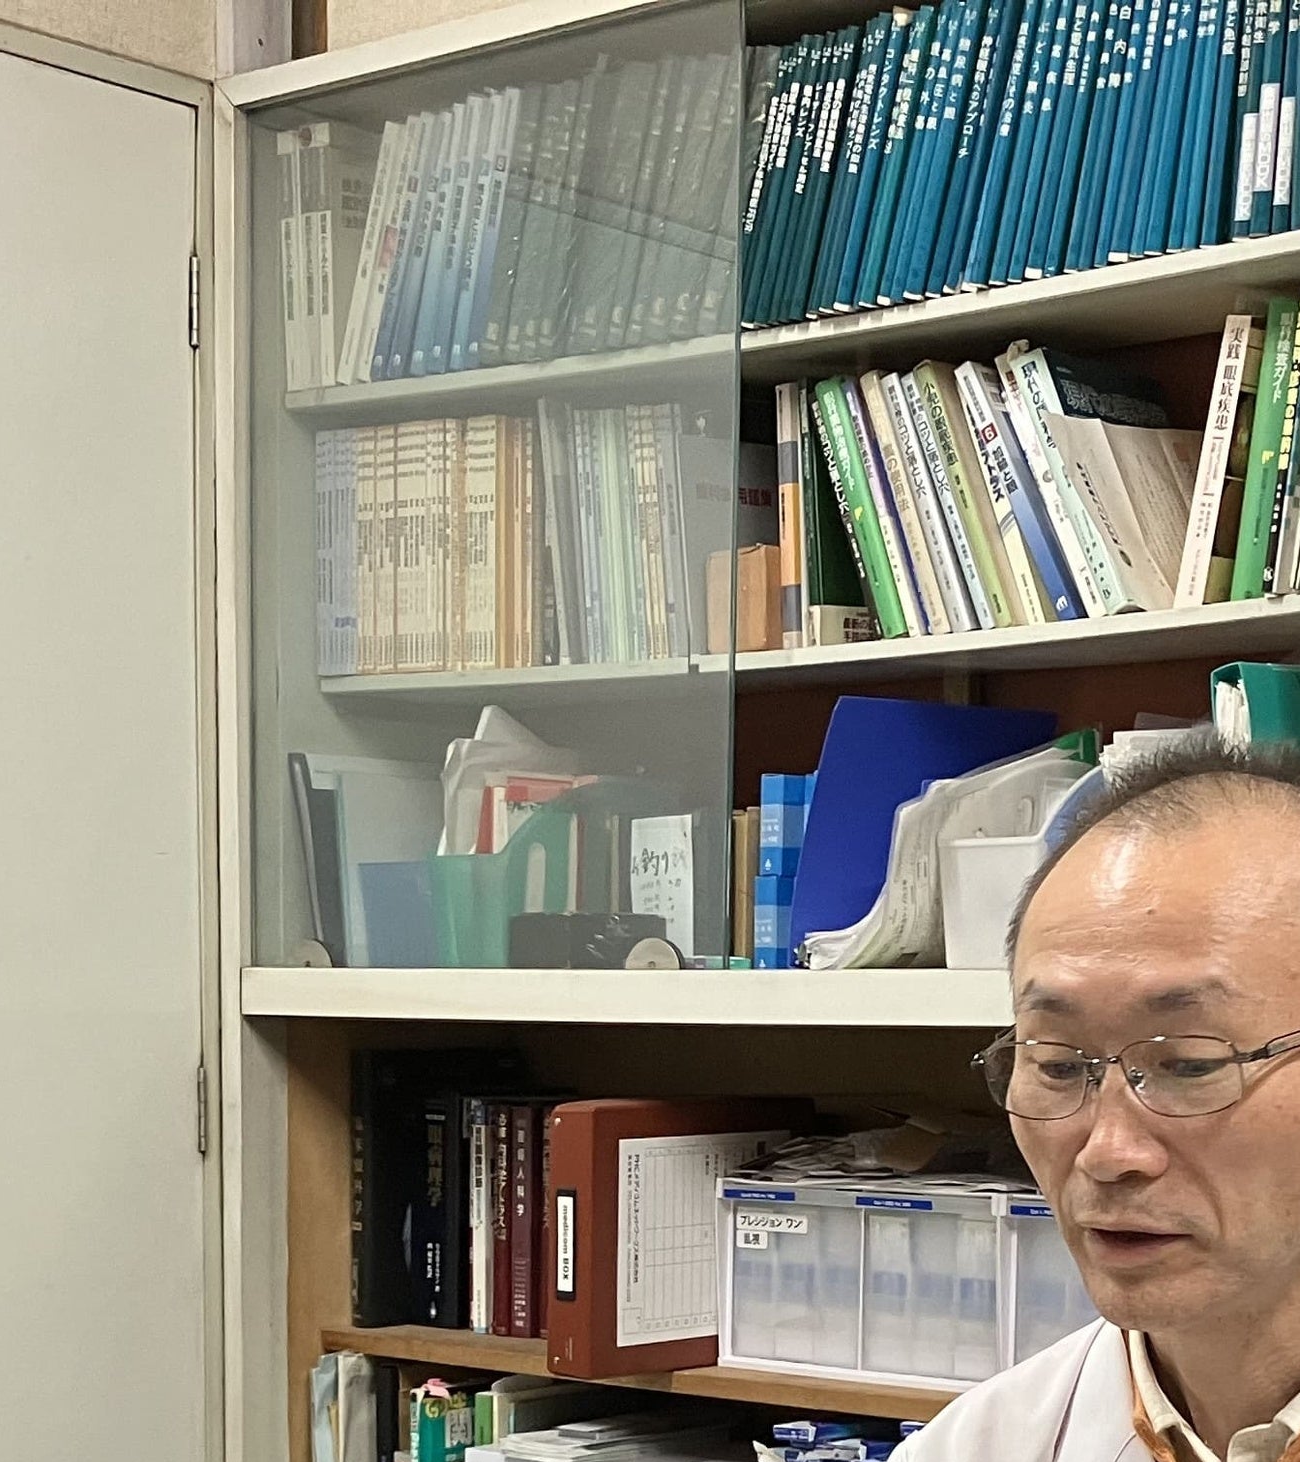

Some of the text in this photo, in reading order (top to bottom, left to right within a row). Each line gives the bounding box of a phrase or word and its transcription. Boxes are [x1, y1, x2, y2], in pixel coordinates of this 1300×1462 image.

[1108, 5, 1131, 88] 白内障
[868, 48, 895, 150] コンタクトレンズ
[958, 35, 994, 159] 神経眼科へのアプローチ
[1214, 326, 1245, 431] 実践 眼底疾患
[561, 1204, 570, 1281] medicom BOX
[785, 1217, 803, 1230] ワン
